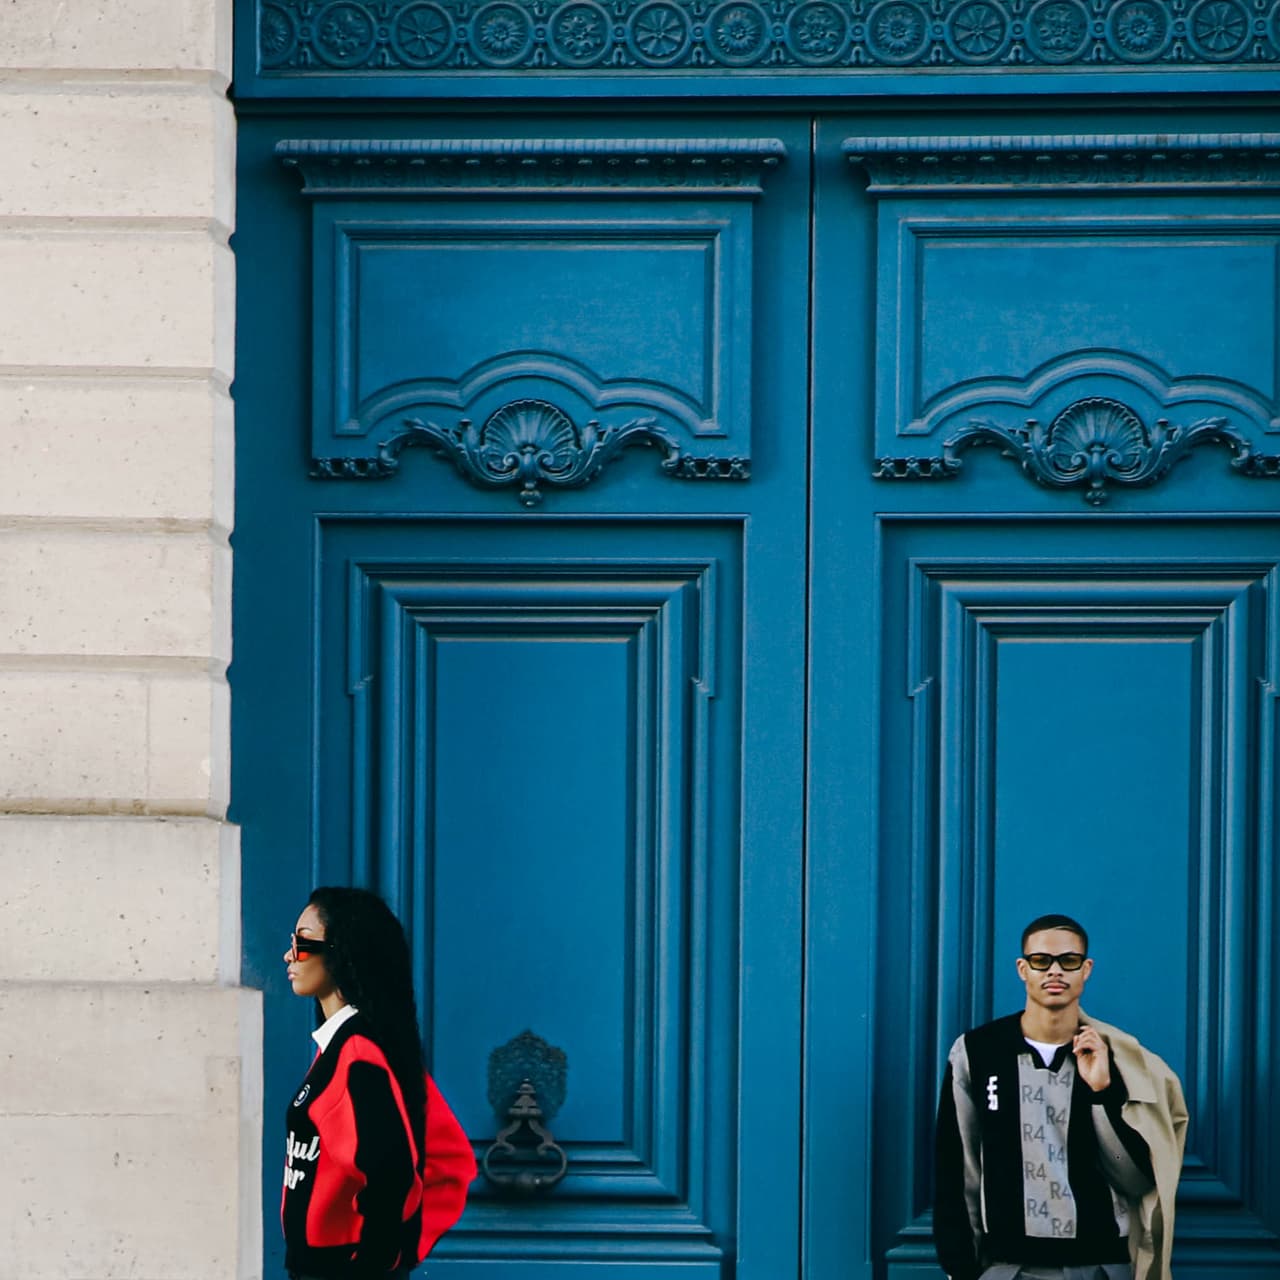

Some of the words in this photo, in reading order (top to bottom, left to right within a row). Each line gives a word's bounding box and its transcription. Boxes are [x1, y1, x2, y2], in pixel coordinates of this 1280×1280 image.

[1022, 1085, 1045, 1105] R4
[1046, 1104, 1067, 1126] R4
[1023, 1123, 1045, 1143] R4
[1024, 1161, 1047, 1181] R4
[1027, 1198, 1049, 1218] R4
[1051, 1218, 1074, 1236] R4
